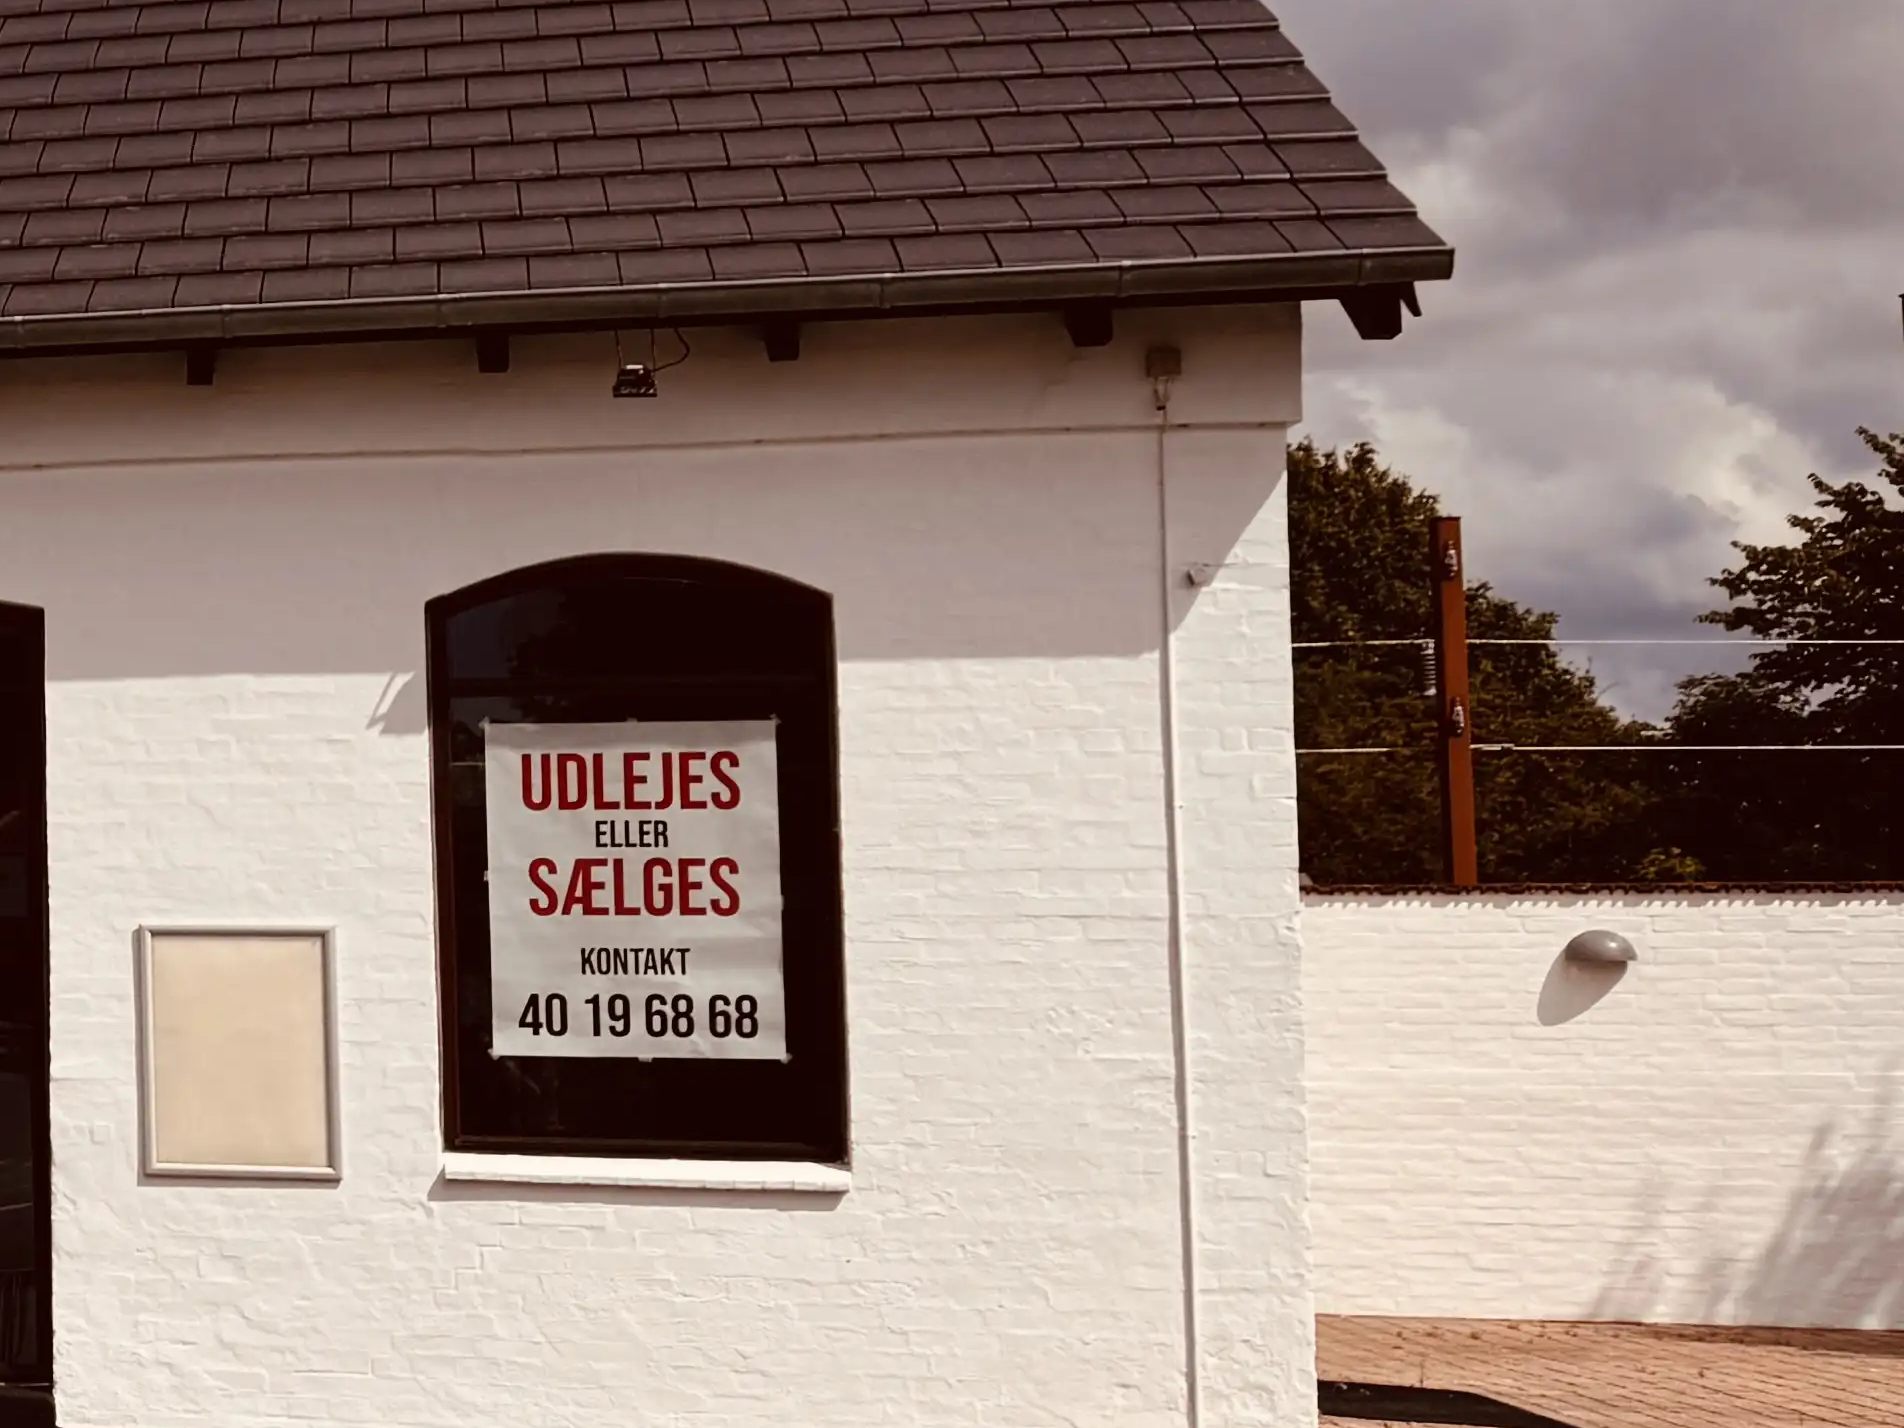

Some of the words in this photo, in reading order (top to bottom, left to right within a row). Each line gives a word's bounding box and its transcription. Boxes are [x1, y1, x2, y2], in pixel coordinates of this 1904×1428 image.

[522, 751, 740, 810] UDLEJES
[595, 820, 668, 847] ELLER
[529, 857, 739, 916] SÆLGES
[581, 948, 690, 975] KONTAKT
[519, 993, 568, 1036] 40
[585, 994, 630, 1037] 19
[645, 994, 694, 1037] 68
[709, 995, 758, 1038] 68
